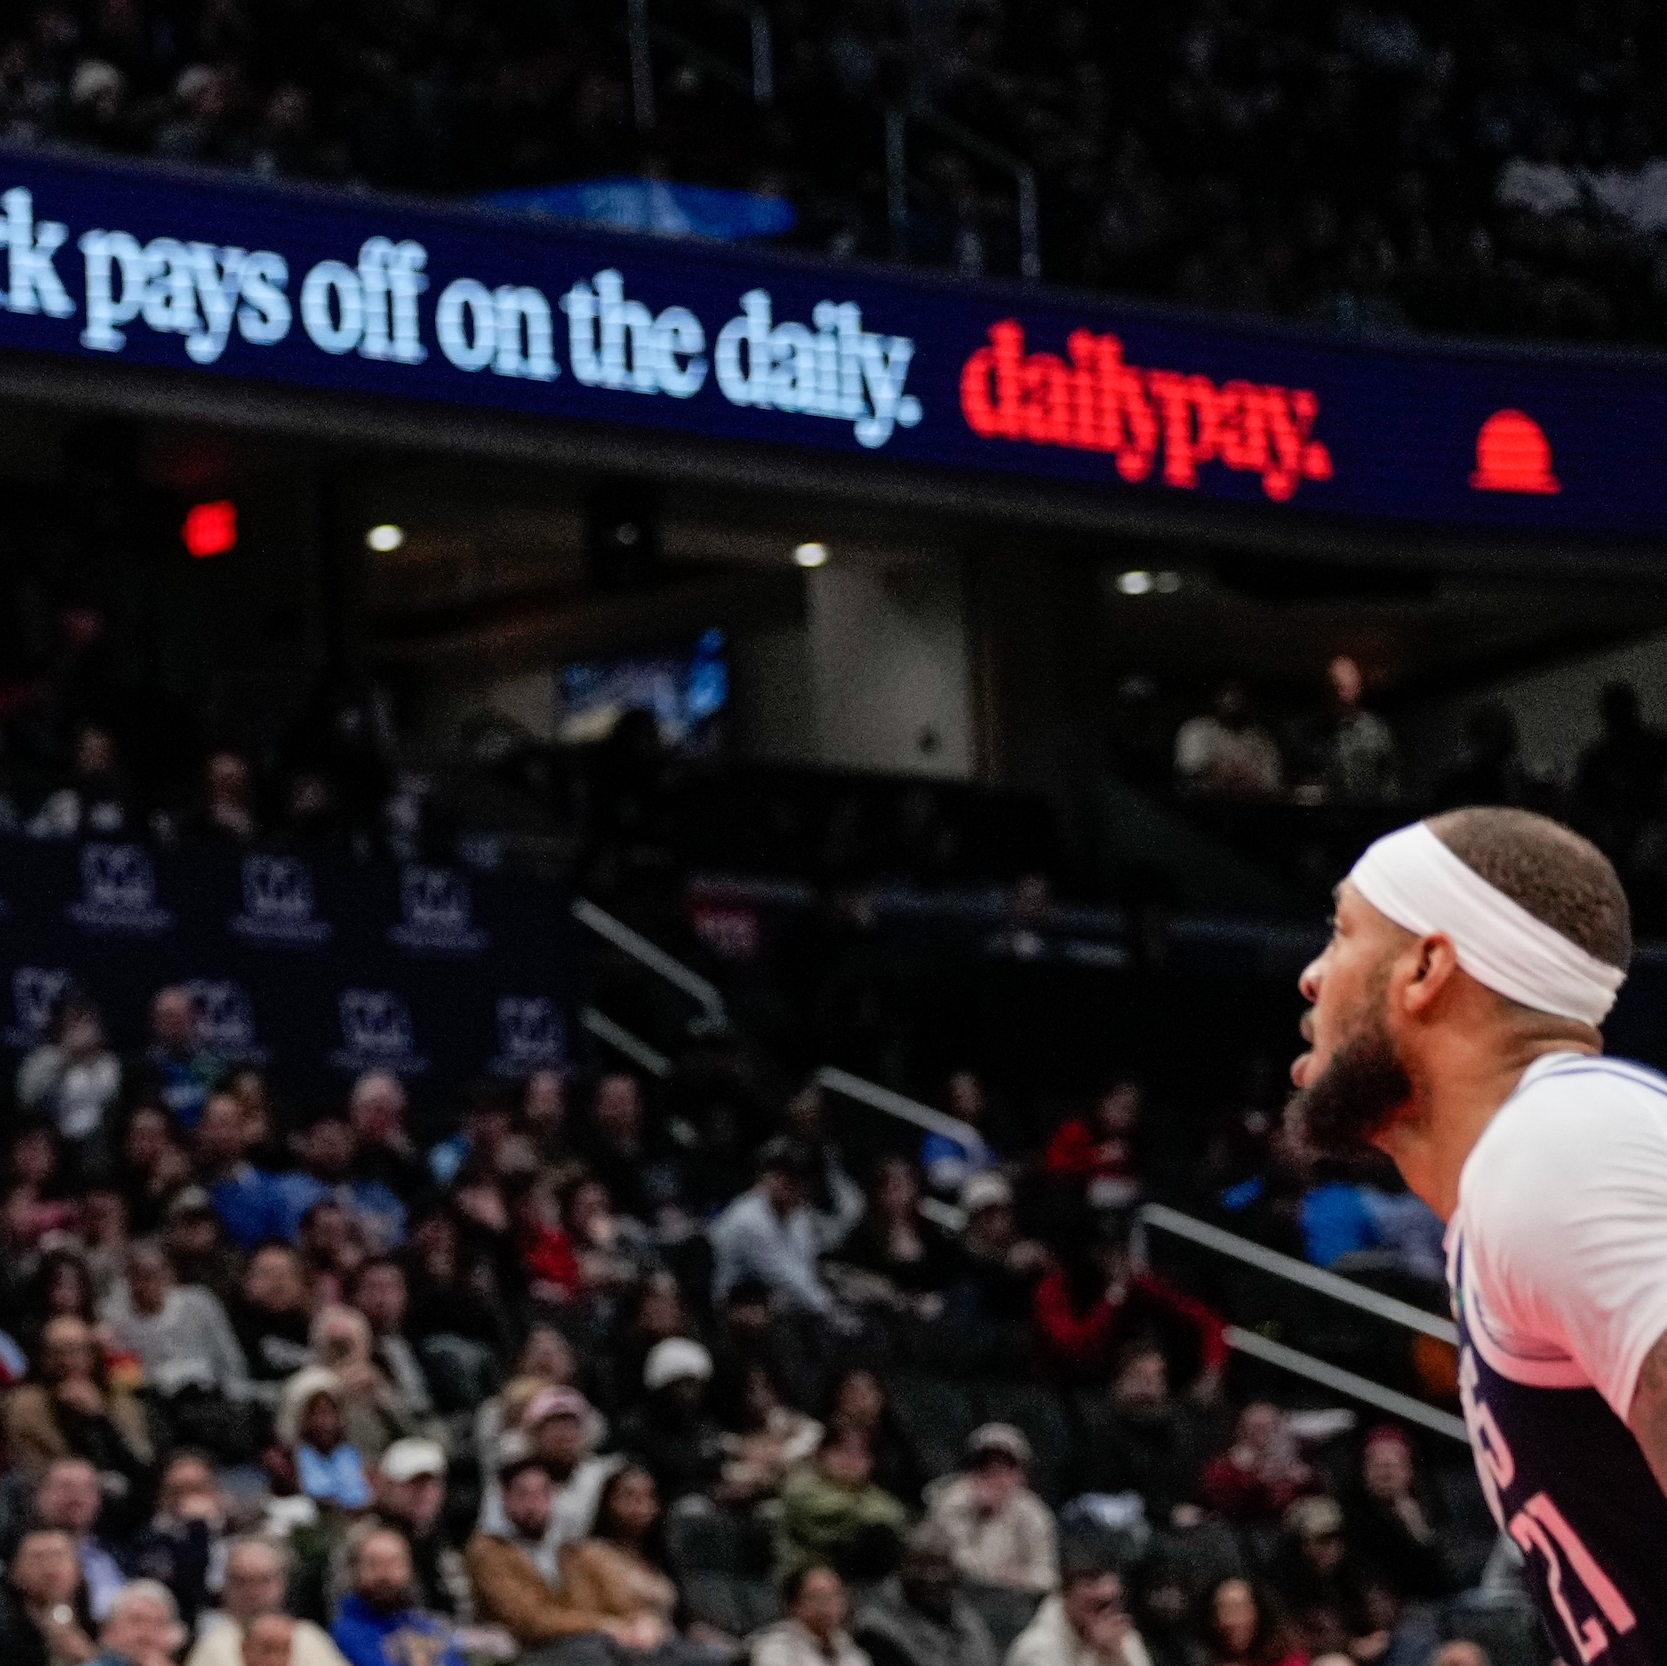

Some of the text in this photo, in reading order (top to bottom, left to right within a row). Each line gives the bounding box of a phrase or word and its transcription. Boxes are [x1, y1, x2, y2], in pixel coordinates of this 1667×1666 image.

[79, 229, 293, 365] pays
[300, 236, 429, 365] off
[435, 277, 561, 382] on
[561, 268, 709, 399] the
[714, 289, 923, 449] daily.
[960, 317, 1334, 502] dailypay.
